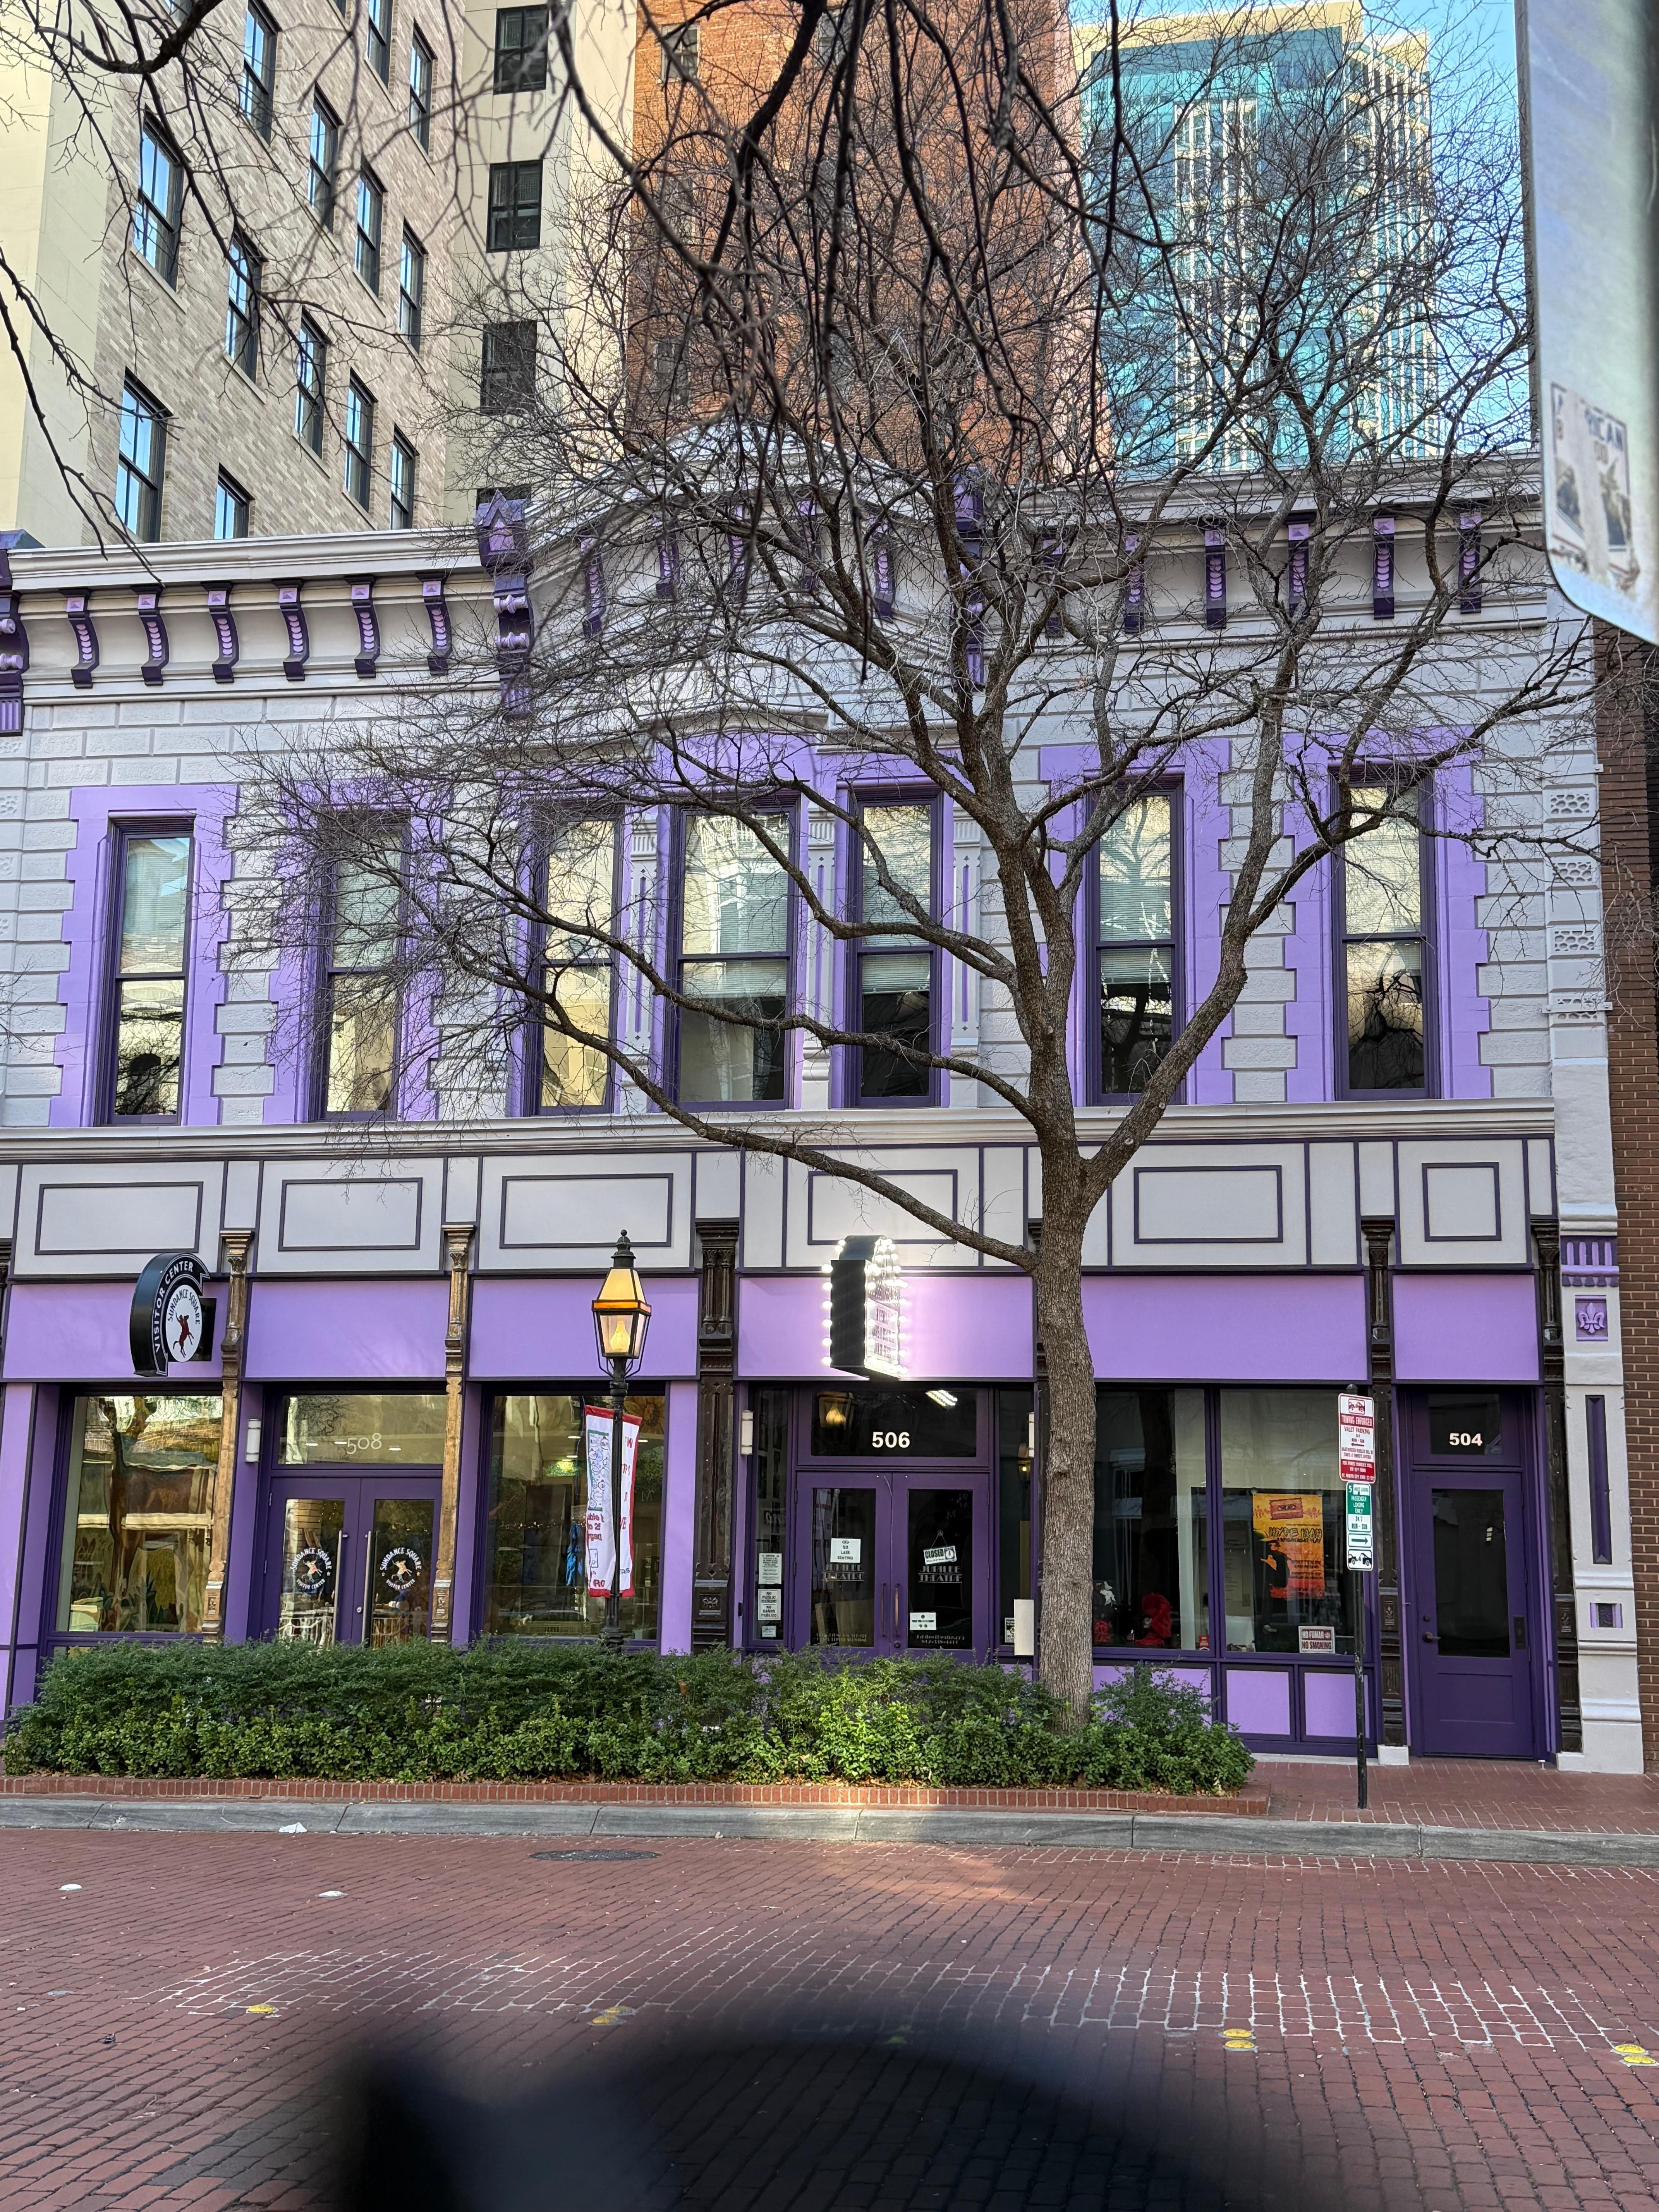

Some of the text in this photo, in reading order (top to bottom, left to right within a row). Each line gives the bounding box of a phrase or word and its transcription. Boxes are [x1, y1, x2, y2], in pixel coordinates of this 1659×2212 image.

[153, 1261, 194, 1353] VISITOR CENTER
[167, 1289, 200, 1325] SUNDANCE SQUARE
[347, 1433, 381, 1454] 508
[872, 1432, 910, 1448] 506
[1449, 1433, 1483, 1446] 504
[1269, 1527, 1298, 1537] HYPE
[290, 1547, 332, 1570] SUNDANCE SQUARE
[380, 1547, 422, 1570] SUNDANCE SQUARE
[925, 1549, 944, 1559] CLOSED
[401, 1579, 416, 1589] CENTER
[1302, 1630, 1324, 1639] NO FUMAR
